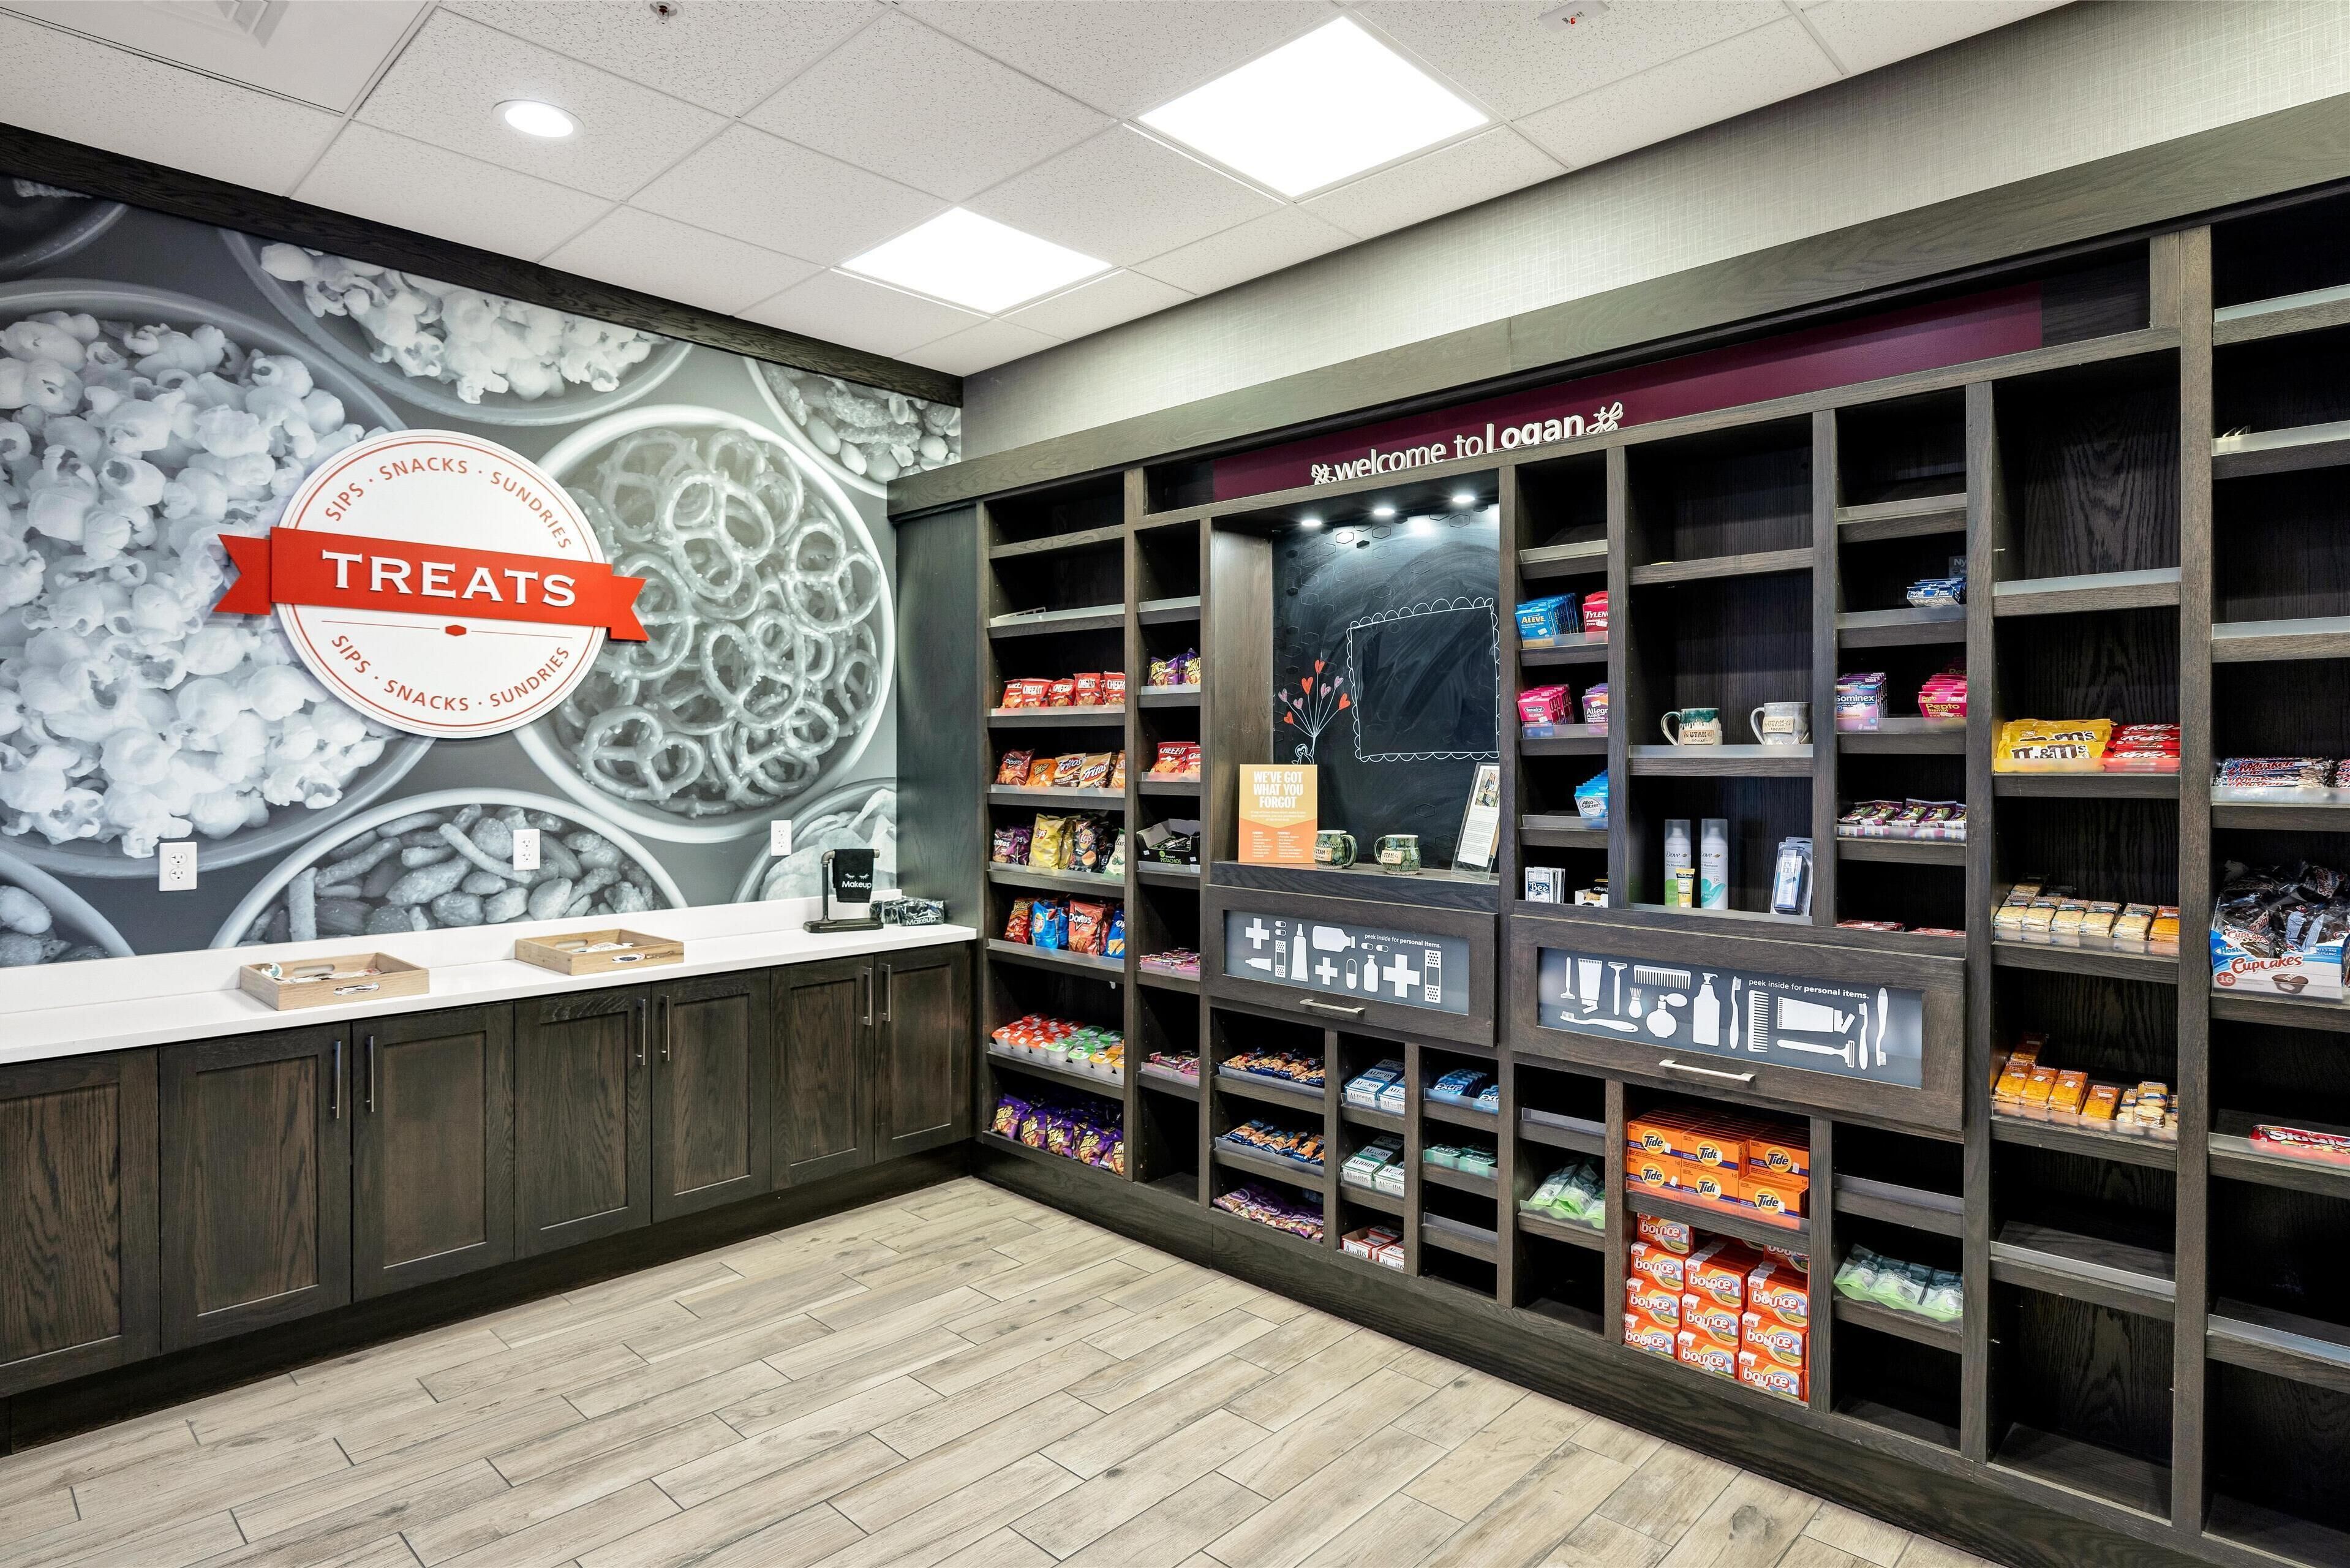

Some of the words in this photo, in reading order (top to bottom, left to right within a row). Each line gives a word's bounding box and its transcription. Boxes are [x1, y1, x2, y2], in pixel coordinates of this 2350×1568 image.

[1335, 443, 1446, 481] welcome
[1454, 434, 1484, 458] to
[326, 483, 364, 521] SIPS
[380, 457, 468, 481] SNACKS
[490, 471, 571, 549] SUNDRIES
[322, 549, 576, 606] TREATS
[331, 635, 371, 674] SIPS
[384, 679, 469, 712] SNACKS
[489, 647, 569, 708] SUNDRIES
[1081, 763, 1107, 780] Fritos
[1254, 771, 1282, 783] WE'VE
[1284, 771, 1303, 783] GOT
[1254, 784, 1281, 796] WHAT
[1283, 784, 1303, 796] YOU
[1259, 796, 1297, 809] FORGOT
[842, 880, 872, 889] Makeup
[1530, 882, 1549, 892] Bee
[906, 915, 936, 926] Makeup
[1768, 981, 1789, 989] inside
[1804, 986, 1840, 995] personal
[1843, 989, 1869, 999] items.
[1644, 1136, 1663, 1149] Tide
[1766, 1153, 1789, 1166] Tide
[1643, 1169, 1662, 1182] Tide
[1698, 1181, 1715, 1193] Tid
[1757, 1194, 1779, 1208] Tide
[1640, 1221, 1681, 1238] bounce
[1634, 1257, 1676, 1275] bounce
[1685, 1310, 1730, 1330] bounce
[1681, 1348, 1725, 1367] bounce
